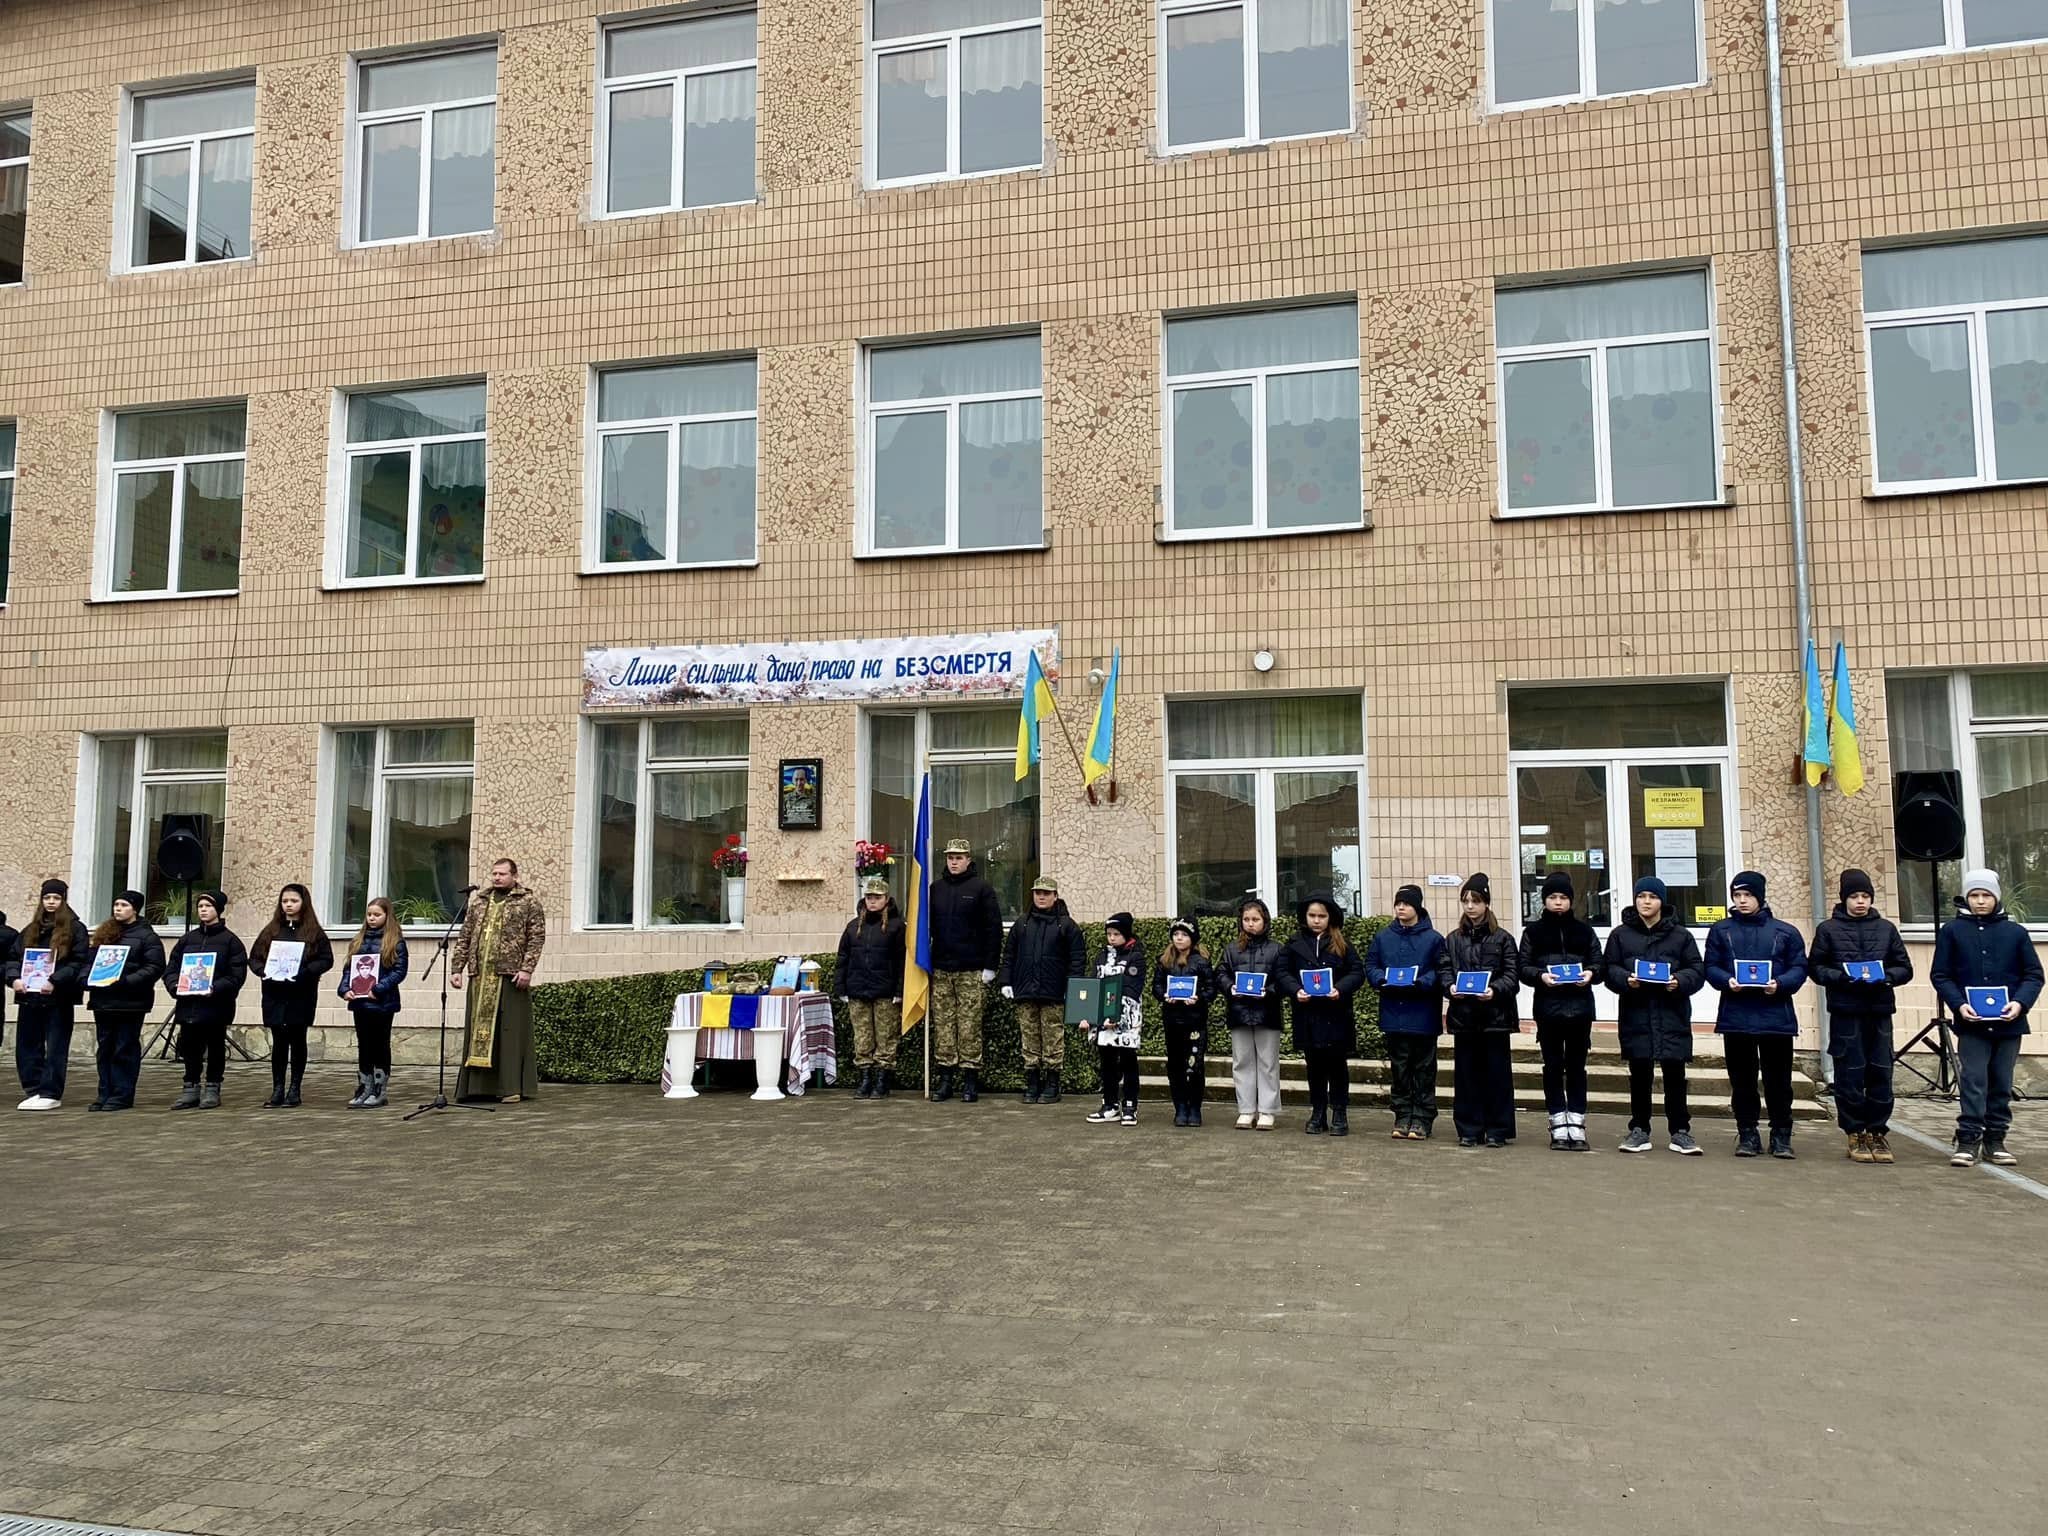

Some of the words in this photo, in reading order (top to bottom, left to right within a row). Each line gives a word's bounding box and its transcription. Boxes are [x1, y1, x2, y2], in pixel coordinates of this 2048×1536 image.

[609, 657, 677, 686] Лише
[687, 663, 758, 684] сильним
[767, 654, 804, 682] дано
[809, 660, 854, 680] право
[861, 658, 883, 679] на
[895, 651, 1012, 677] БЕЗСМЕРТЯ
